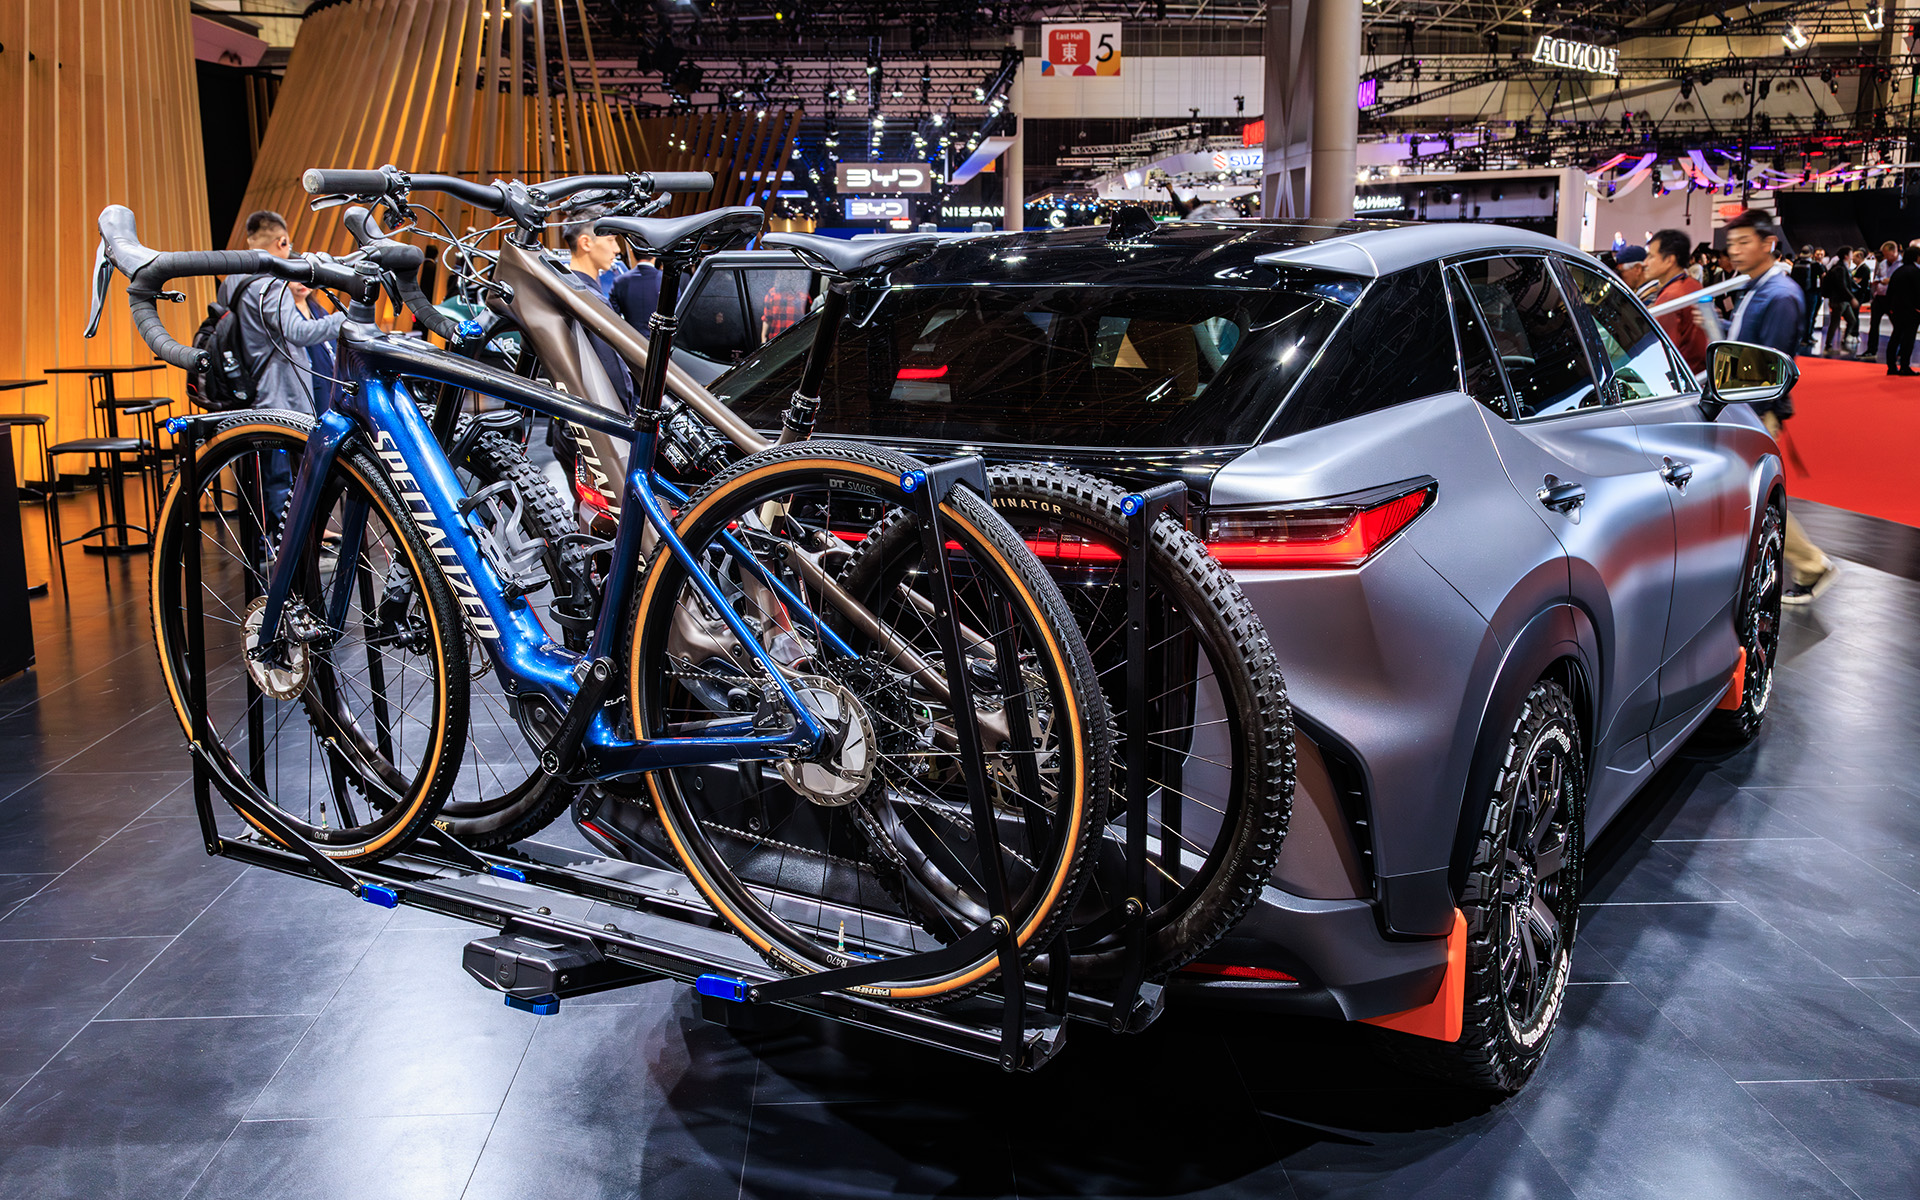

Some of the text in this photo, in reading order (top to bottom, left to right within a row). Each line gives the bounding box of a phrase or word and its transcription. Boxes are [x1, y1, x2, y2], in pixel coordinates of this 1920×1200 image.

[1056, 32, 1084, 40] East Hall
[1061, 42, 1078, 63] 東
[1095, 33, 1113, 62] 5
[1230, 155, 1264, 167] SUZ
[846, 168, 924, 188] BYD
[851, 202, 903, 216] BYD
[941, 206, 1005, 217] NISSAN
[829, 478, 877, 496] DT SWISS
[991, 498, 1062, 515] MINATOR
[370, 430, 500, 639] SPECIALIZED
[826, 953, 848, 968] R470
